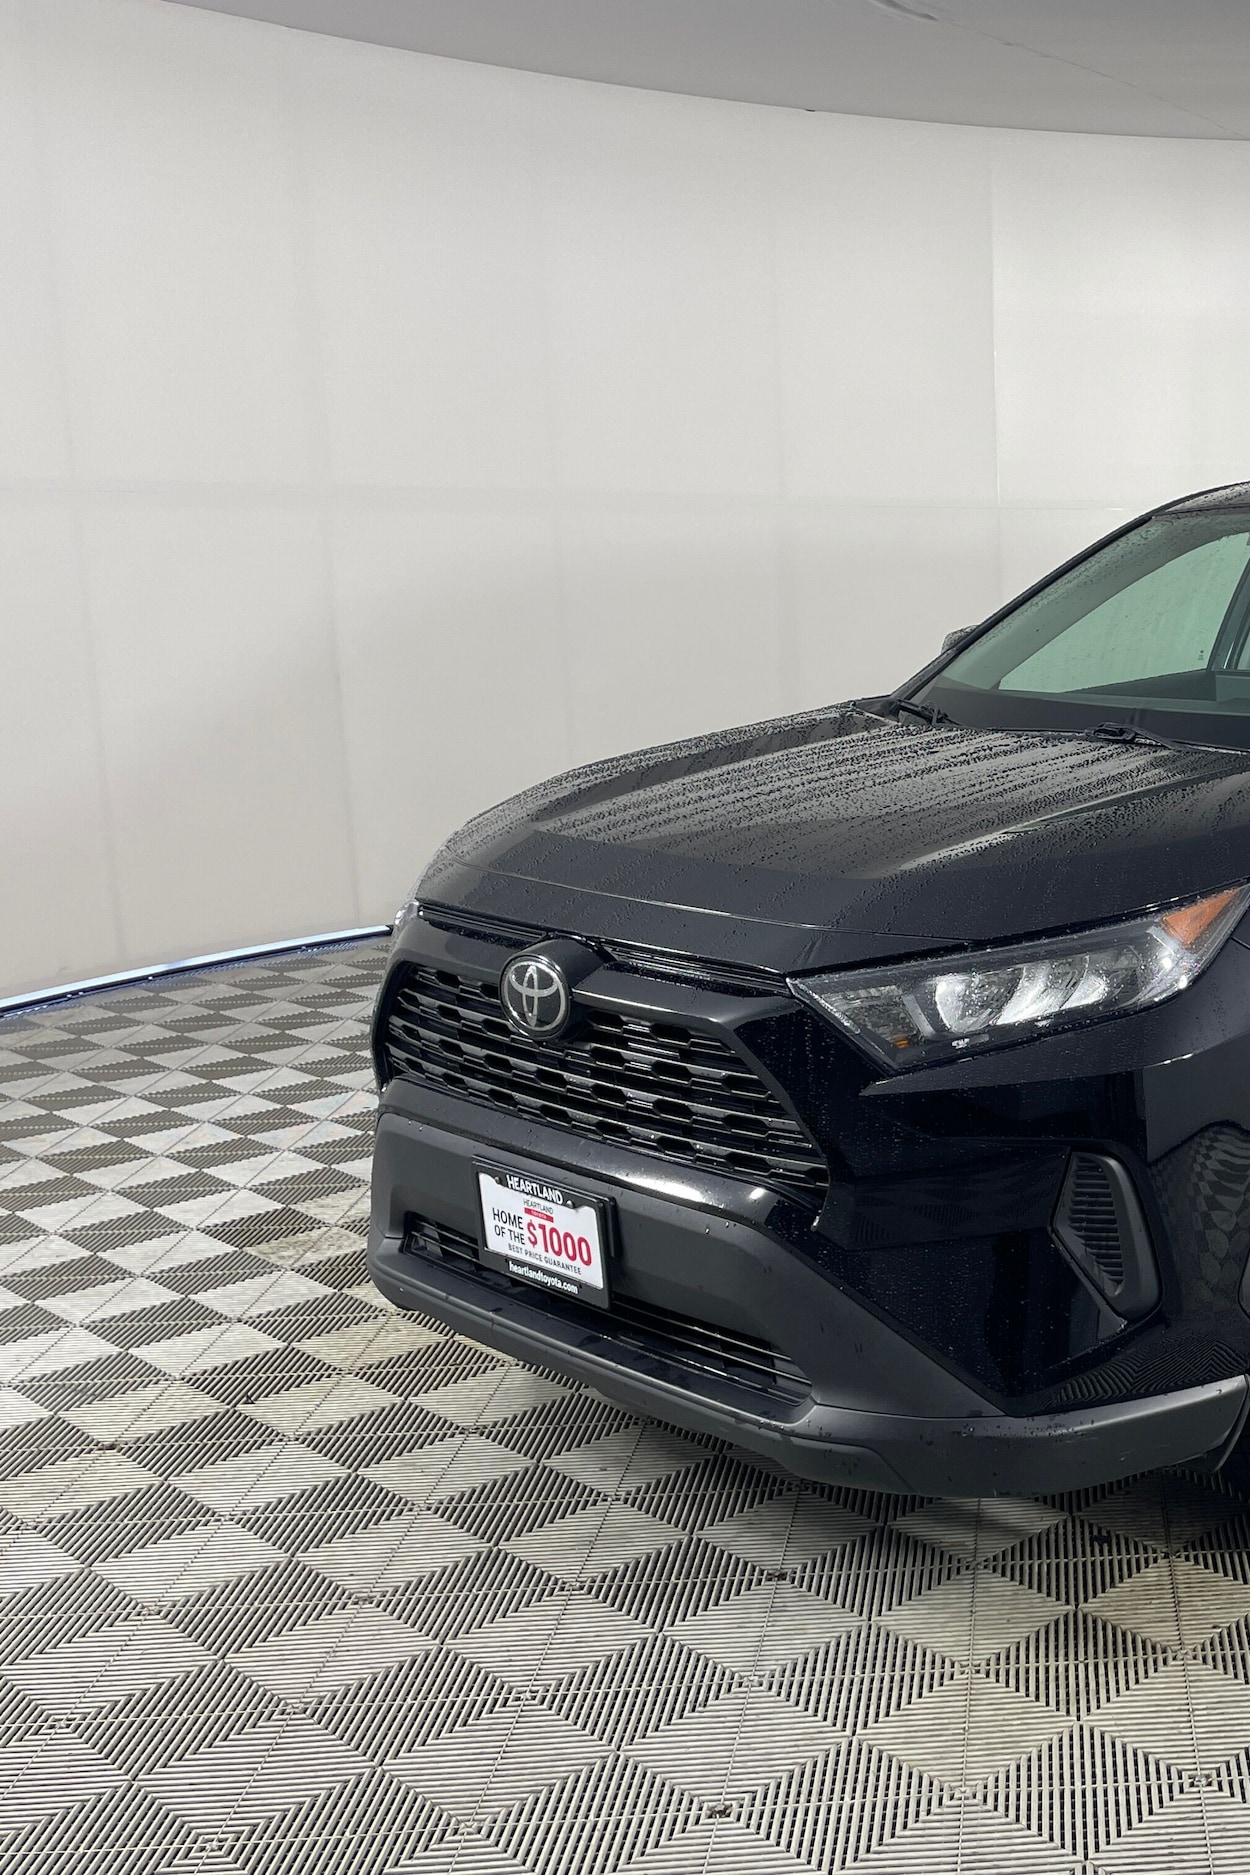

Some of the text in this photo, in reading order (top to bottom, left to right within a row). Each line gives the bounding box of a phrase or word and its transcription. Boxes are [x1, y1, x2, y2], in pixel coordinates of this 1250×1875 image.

[506, 1175, 564, 1205] HEARTLAND
[492, 1207, 524, 1231] HOME
[523, 1199, 554, 1215] HEARTLAND
[494, 1225, 526, 1245] OF THE
[527, 1219, 592, 1267] $1000
[508, 1243, 582, 1275] BEST PRICE GUARANTEE
[508, 1260, 579, 1295] heartlandtoyota.com
